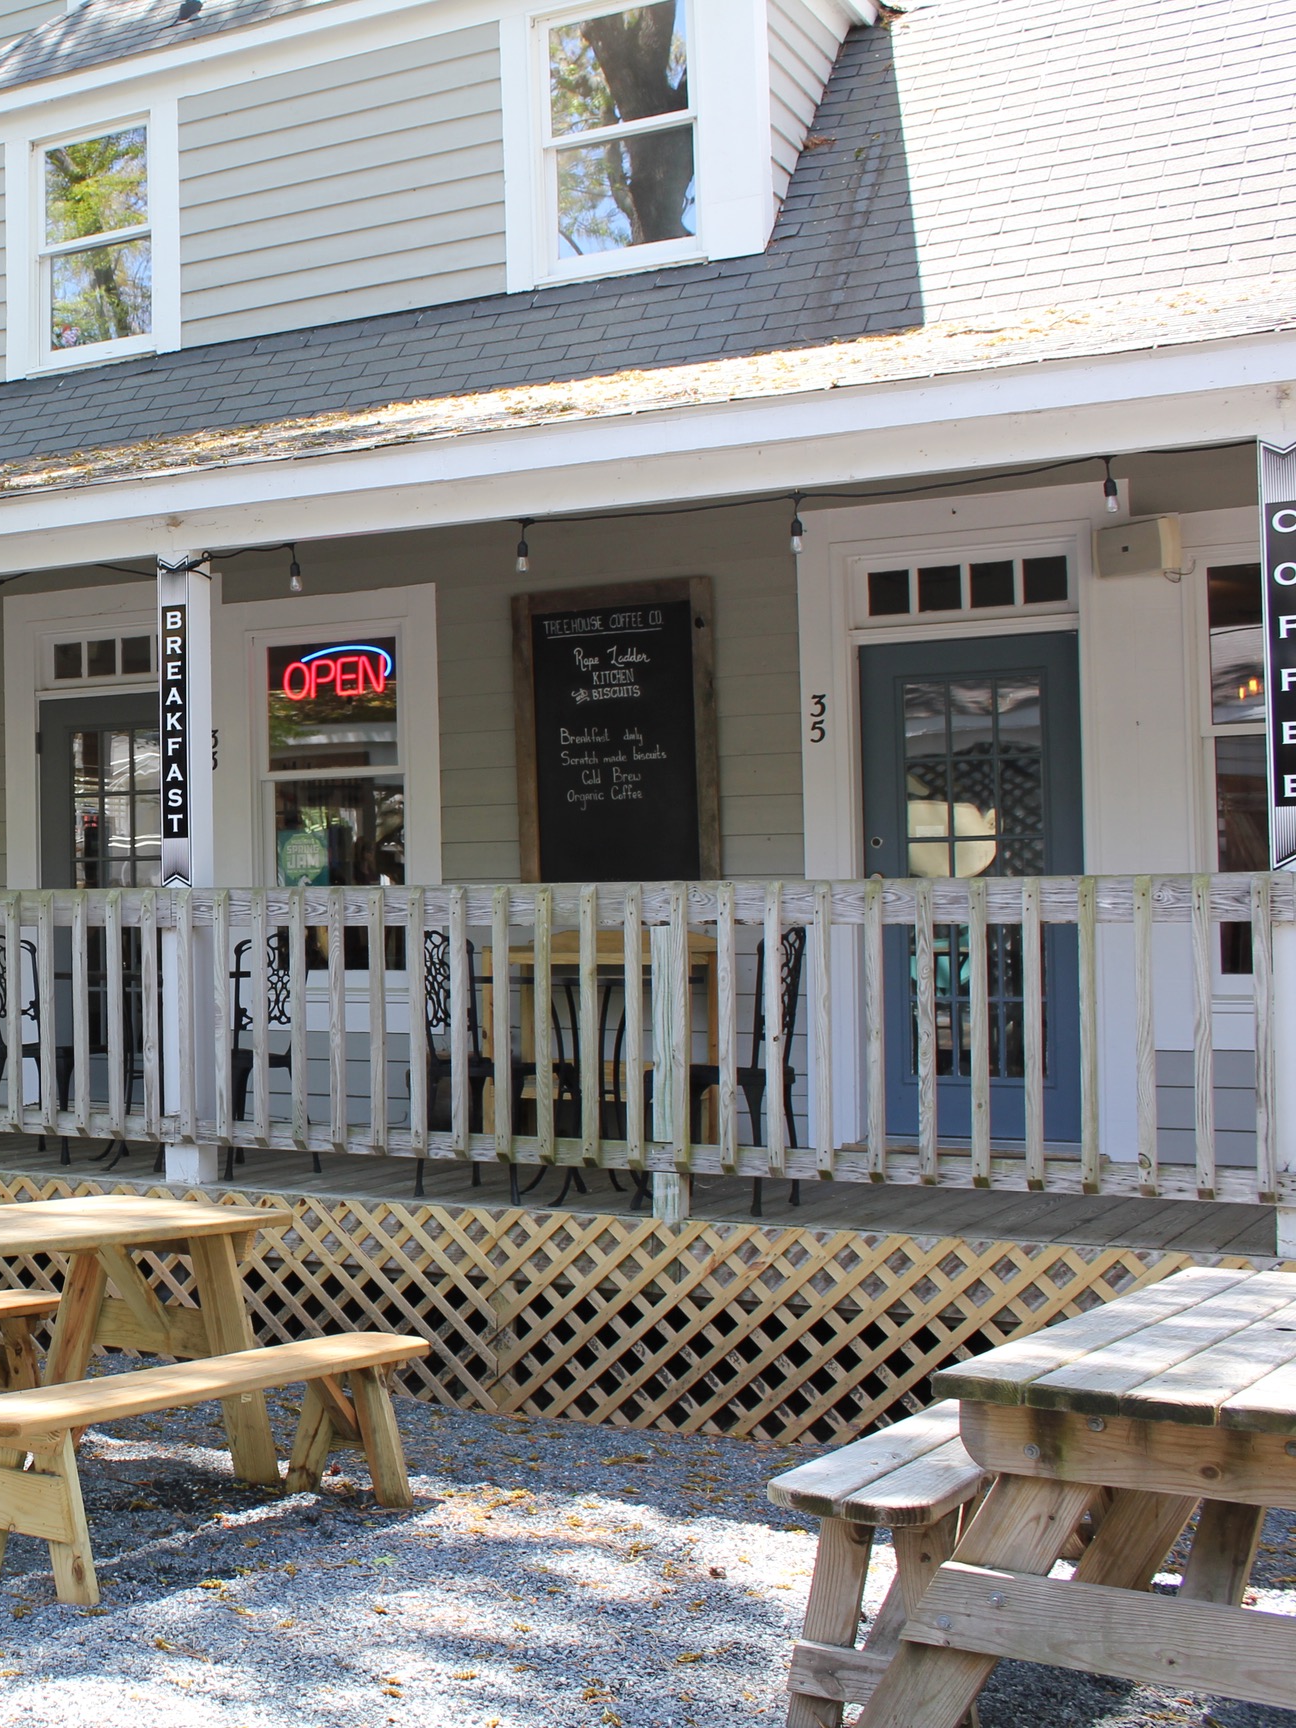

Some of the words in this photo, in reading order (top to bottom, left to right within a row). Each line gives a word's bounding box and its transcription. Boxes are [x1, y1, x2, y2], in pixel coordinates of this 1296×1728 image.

[543, 615, 604, 635] TREEHOUSE
[609, 611, 643, 629] COFFEE
[606, 645, 651, 667] Ladder
[1271, 508, 1296, 798] COFFEE
[283, 654, 386, 701] OPEN
[592, 668, 635, 685] KITCHEN
[592, 685, 641, 700] BISCUITS
[164, 610, 184, 833] BREAKFAST
[810, 693, 827, 744] 35
[560, 727, 610, 745] Breakfast
[623, 727, 643, 747] daily
[560, 750, 599, 766] Scratch
[603, 750, 628, 763] made
[633, 744, 667, 761] biscuits
[581, 769, 602, 785] Cold
[612, 766, 642, 783] Brew
[567, 789, 605, 811] Organic
[610, 784, 643, 800] Coffee
[286, 844, 320, 854] SPRING
[286, 853, 320, 869] JAM
